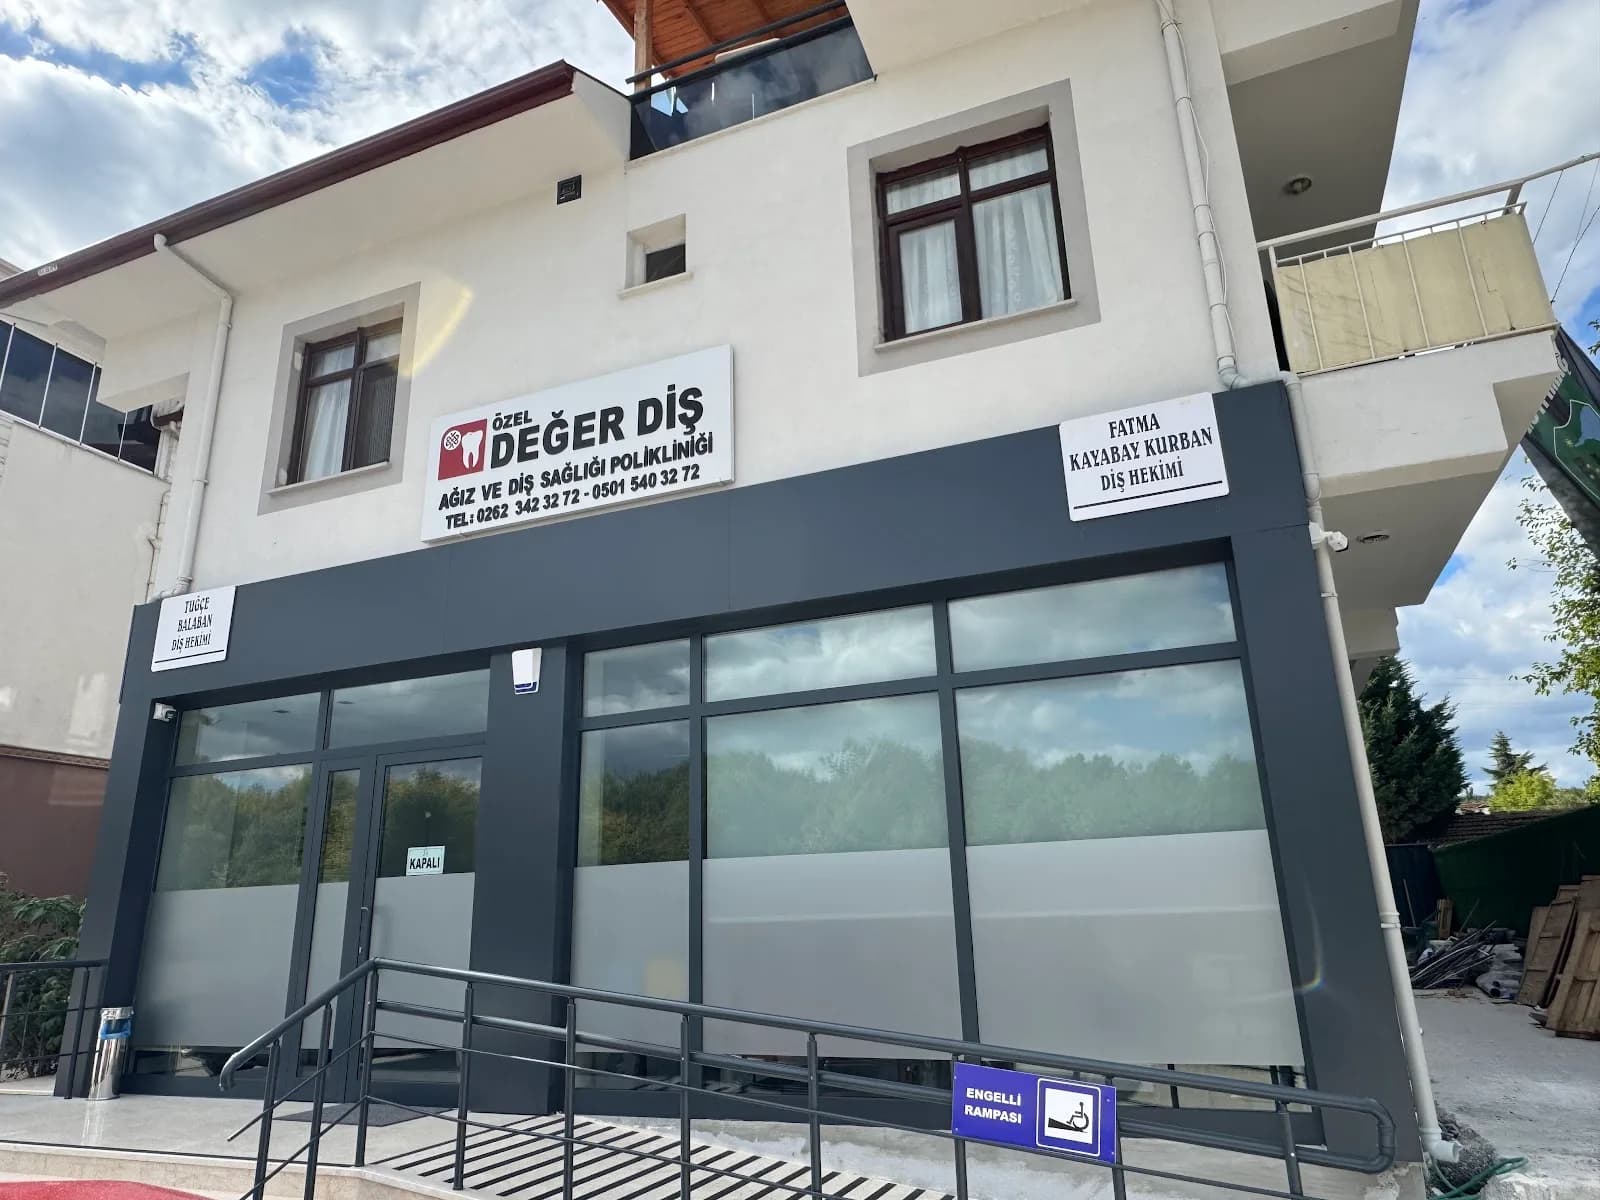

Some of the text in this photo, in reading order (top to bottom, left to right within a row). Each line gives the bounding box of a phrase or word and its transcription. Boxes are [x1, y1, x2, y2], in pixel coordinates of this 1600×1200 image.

[491, 384, 704, 469] DEĞER DİŞ
[493, 410, 533, 431] ÖZEL
[1108, 412, 1161, 439] FATMA
[1069, 427, 1213, 472] KAYABAY KURBAN
[439, 432, 713, 511] AĞIZ VE DİŞ SAĞLIĞI POLİKLİNİĞİ
[1101, 456, 1184, 492] DİŞ HEKİMİ
[446, 498, 474, 530] TEL:
[477, 503, 509, 523] 0262
[515, 497, 539, 515] 342
[543, 493, 559, 510] 32
[563, 488, 580, 505] 72
[592, 479, 625, 500] 0501
[630, 472, 657, 492] 540
[660, 468, 678, 486] 32
[682, 463, 700, 482] 72
[184, 595, 210, 614] TUĞÇE
[177, 613, 213, 632] BALABAN
[171, 629, 211, 654] DİŞ HEKİMİ
[409, 856, 440, 870] KAPALI
[966, 1087, 1022, 1107] ENGELLİ
[964, 1104, 1022, 1124] RAMPASI
